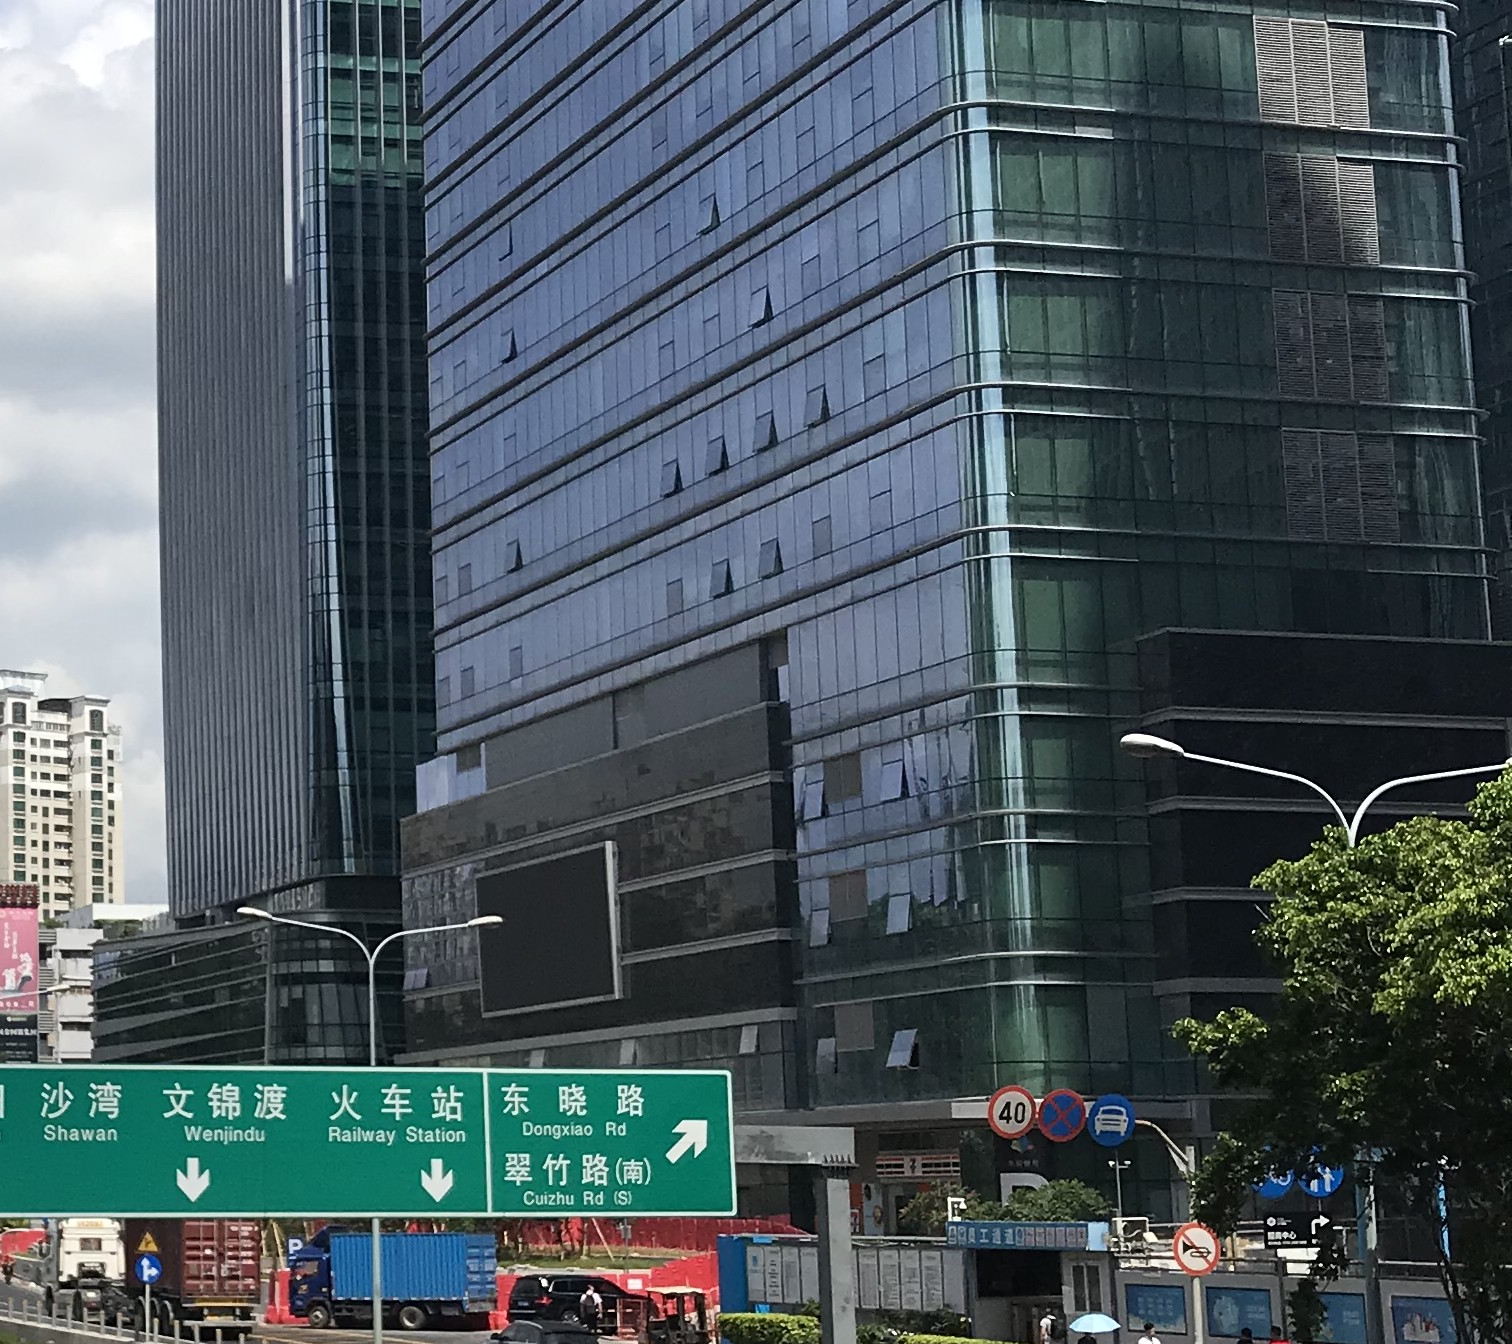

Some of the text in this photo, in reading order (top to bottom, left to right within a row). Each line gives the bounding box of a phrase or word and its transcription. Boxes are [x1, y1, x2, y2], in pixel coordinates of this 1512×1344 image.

[40, 1081, 122, 1119] 沙湾
[162, 1082, 288, 1121] 文锦渡
[329, 1083, 464, 1122] 火车站
[501, 1082, 645, 1117] 东晓路
[998, 1101, 1026, 1124] 40
[43, 1124, 117, 1142] Shawan
[184, 1125, 265, 1145] Wenjindu
[328, 1126, 396, 1146] Railway
[405, 1126, 466, 1143] Station
[522, 1121, 627, 1140] Dongxiao Rd
[503, 1153, 652, 1187] 翠竹路(南)
[523, 1190, 632, 1207] Cuizhu Rd (S)
[289, 1238, 303, 1254] P
